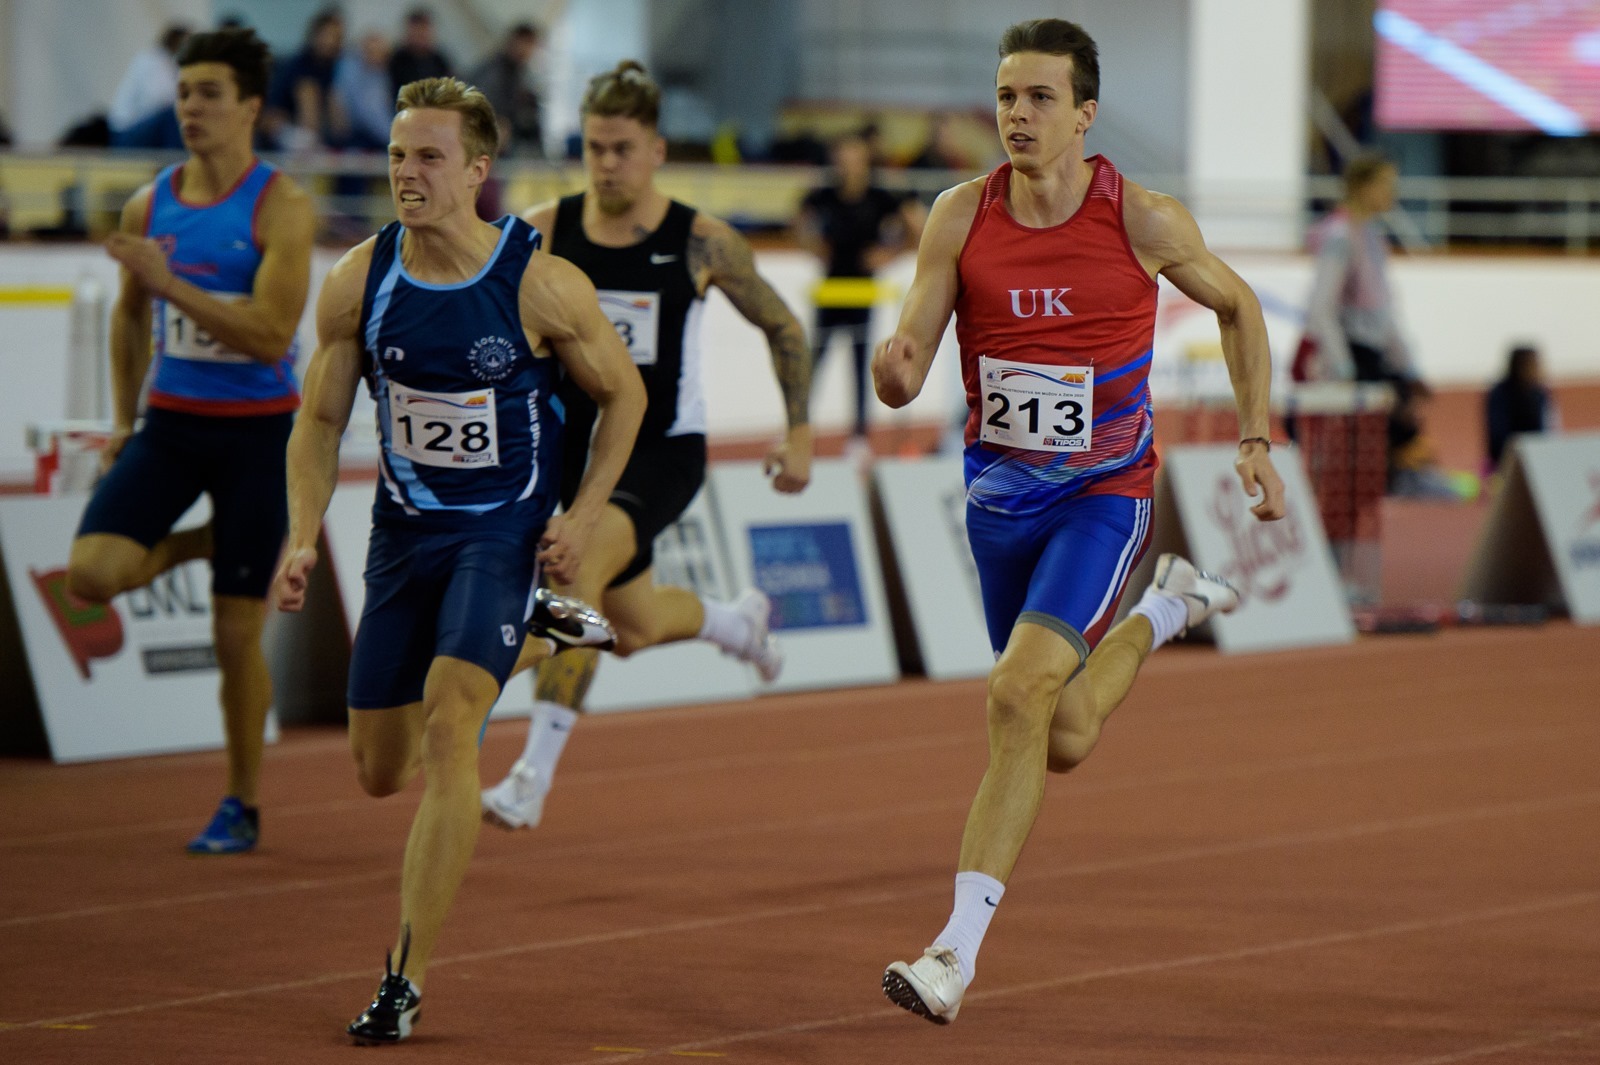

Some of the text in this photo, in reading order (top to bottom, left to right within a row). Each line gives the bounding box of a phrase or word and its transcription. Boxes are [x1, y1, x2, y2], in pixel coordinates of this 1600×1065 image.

[1007, 287, 1074, 318] UK
[986, 392, 1085, 436] 213
[397, 415, 491, 453] 128
[1054, 439, 1083, 447] TIPOS
